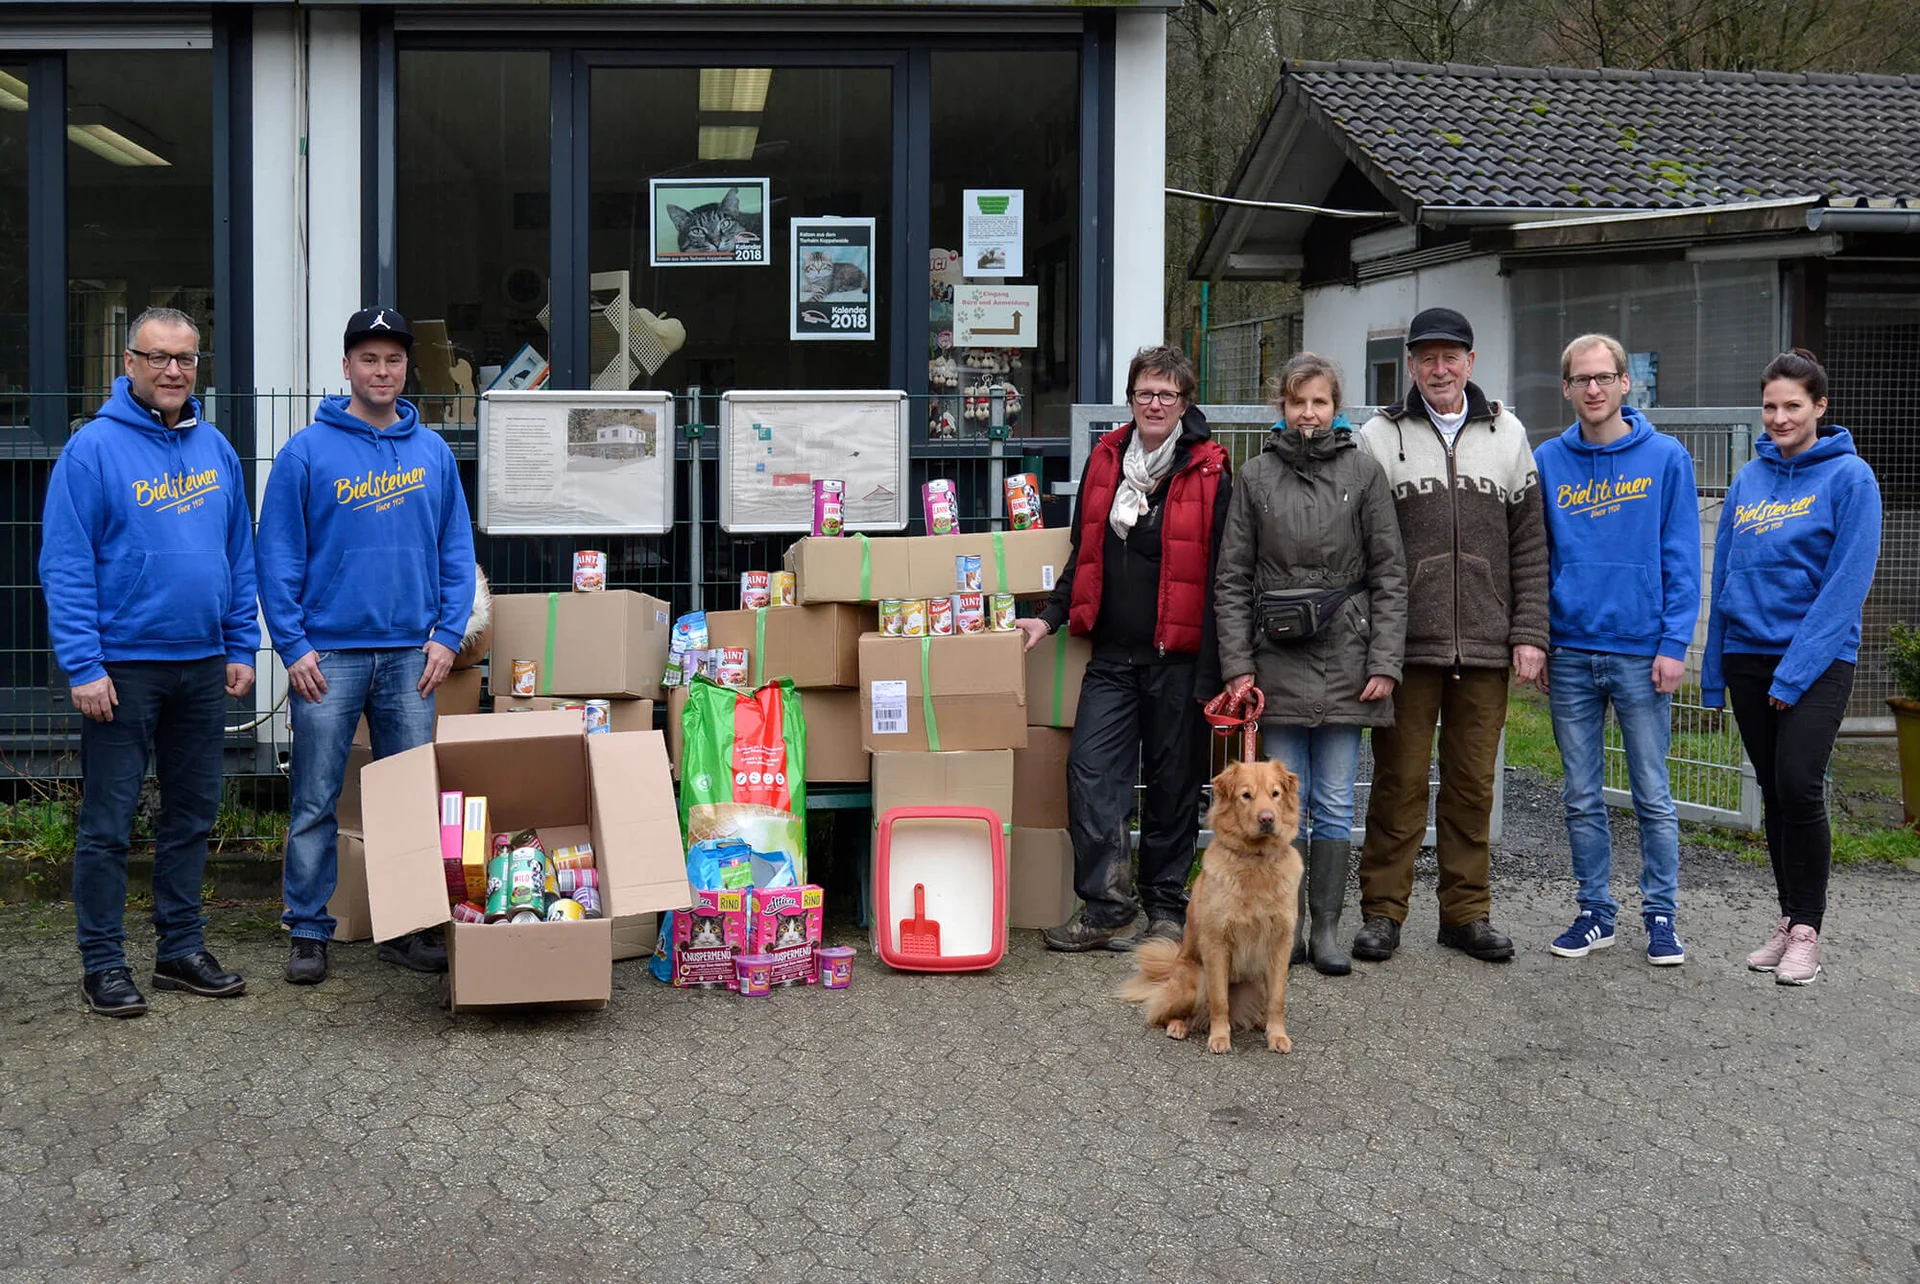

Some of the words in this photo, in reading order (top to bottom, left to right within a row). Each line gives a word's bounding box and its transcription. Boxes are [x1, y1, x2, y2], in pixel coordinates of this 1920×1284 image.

[735, 250, 762, 261] 2018
[930, 257, 947, 271] ICI
[831, 306, 867, 314] Kalender
[993, 299, 1030, 307] Anmeldung
[831, 314, 867, 328] 2018
[132, 467, 219, 507] Bielsteiner
[333, 465, 426, 505] Bielsteiner
[766, 895, 796, 912] Attica
[771, 943, 812, 962] USPERMENÜ
